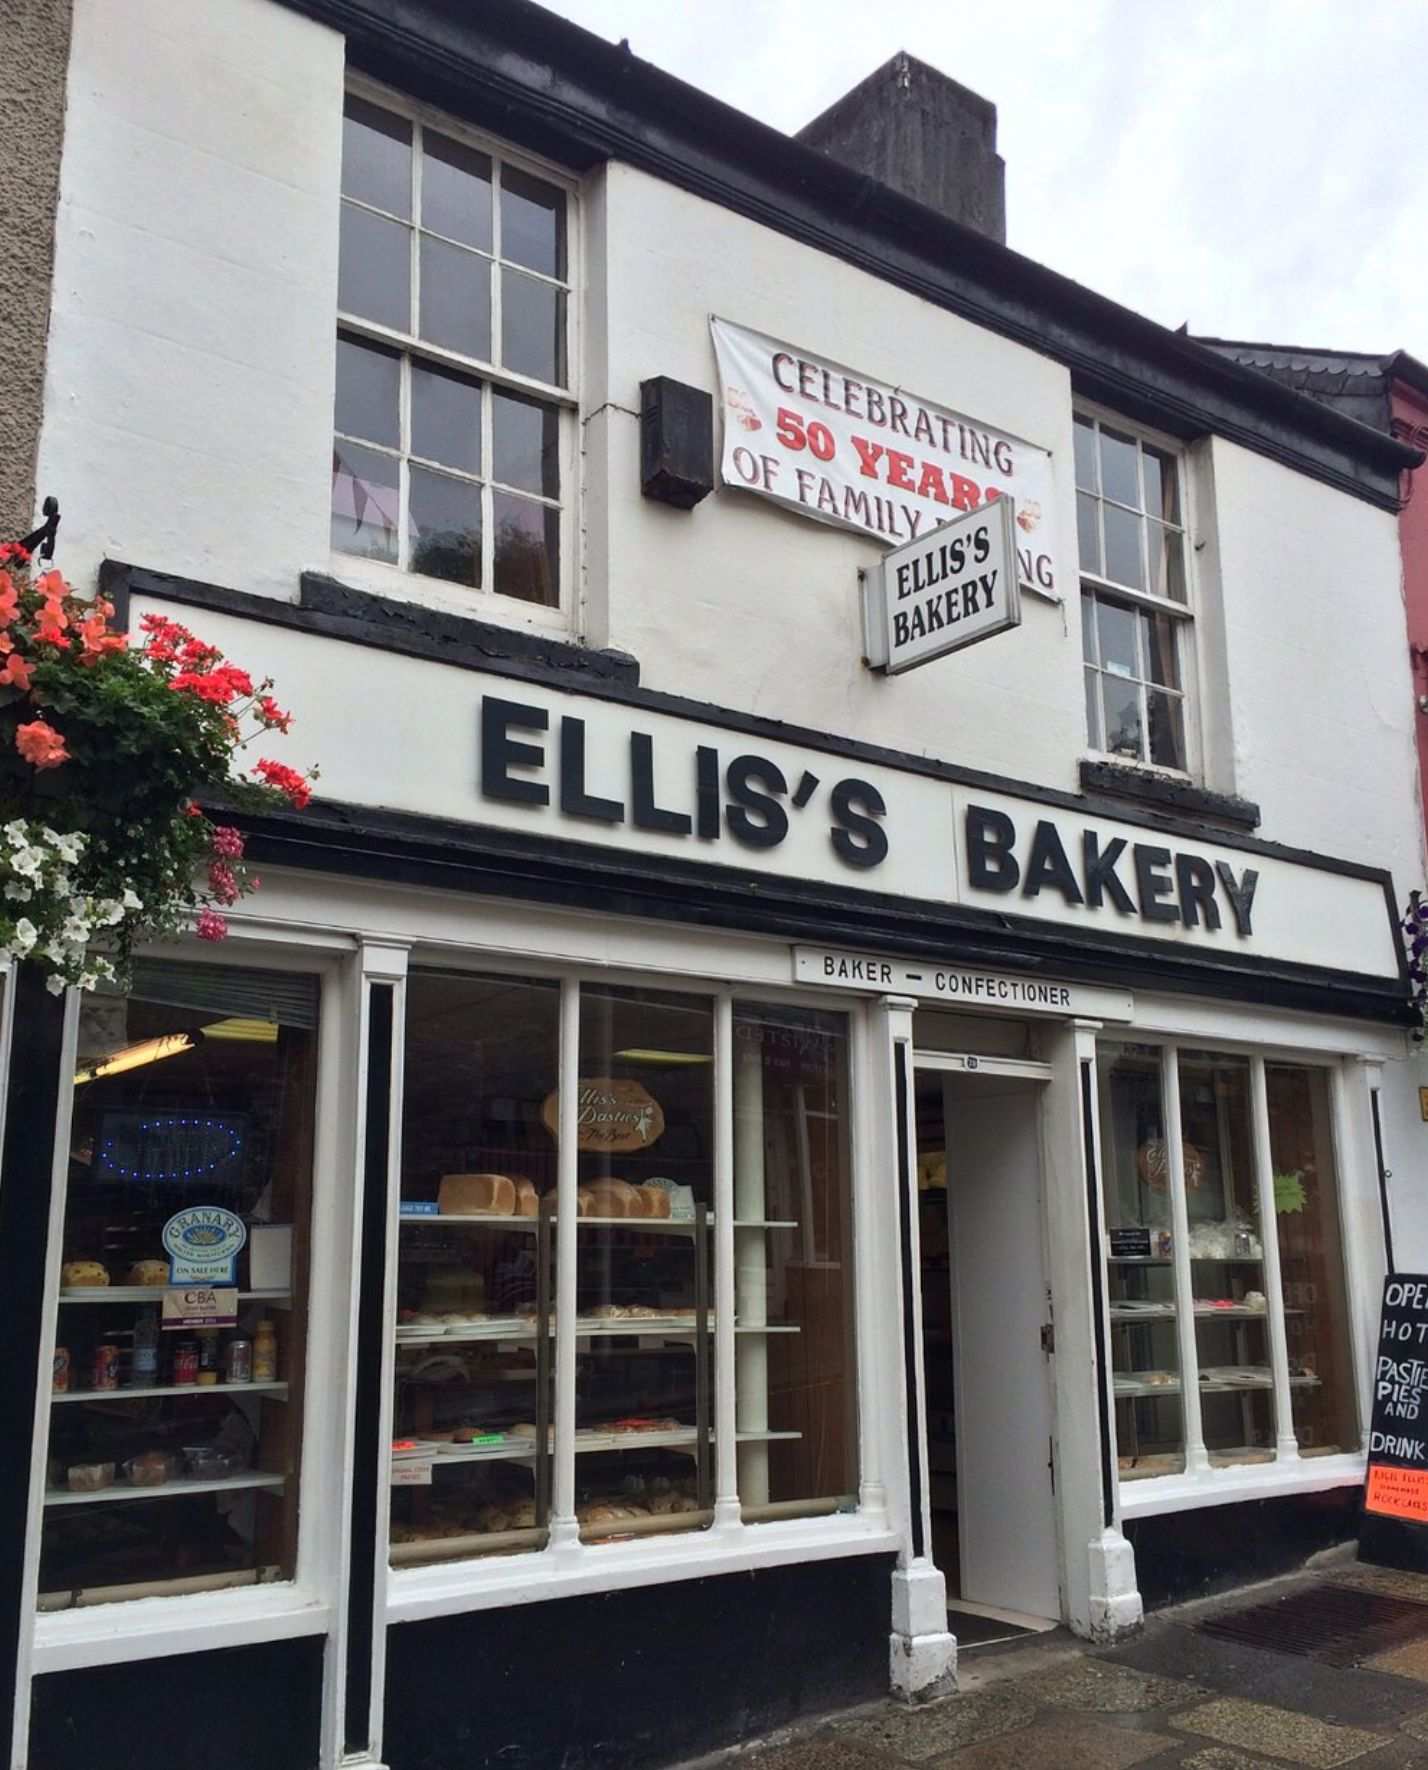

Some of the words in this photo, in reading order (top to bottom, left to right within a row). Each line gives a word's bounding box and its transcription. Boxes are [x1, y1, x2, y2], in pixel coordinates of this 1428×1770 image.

[771, 352, 1014, 477] CELEBRATING
[775, 406, 837, 462] 50
[732, 446, 781, 491] OF
[795, 467, 922, 538] FAMILY
[896, 525, 991, 601] ELLIS'S
[893, 569, 998, 649] BAKERY
[481, 694, 889, 870] ELLIS'S
[966, 803, 1260, 938] BAKERY
[823, 955, 893, 984] BAKER
[935, 971, 1071, 1007] CONFECTIONER
[169, 1212, 240, 1238] GRANARY
[184, 1290, 217, 1305] CBA
[1385, 1283, 1428, 1309] OPE
[1383, 1320, 1428, 1343] HOT
[1377, 1381, 1422, 1405] PIES
[1384, 1402, 1420, 1420] AND
[1370, 1431, 1426, 1460] DRINK
